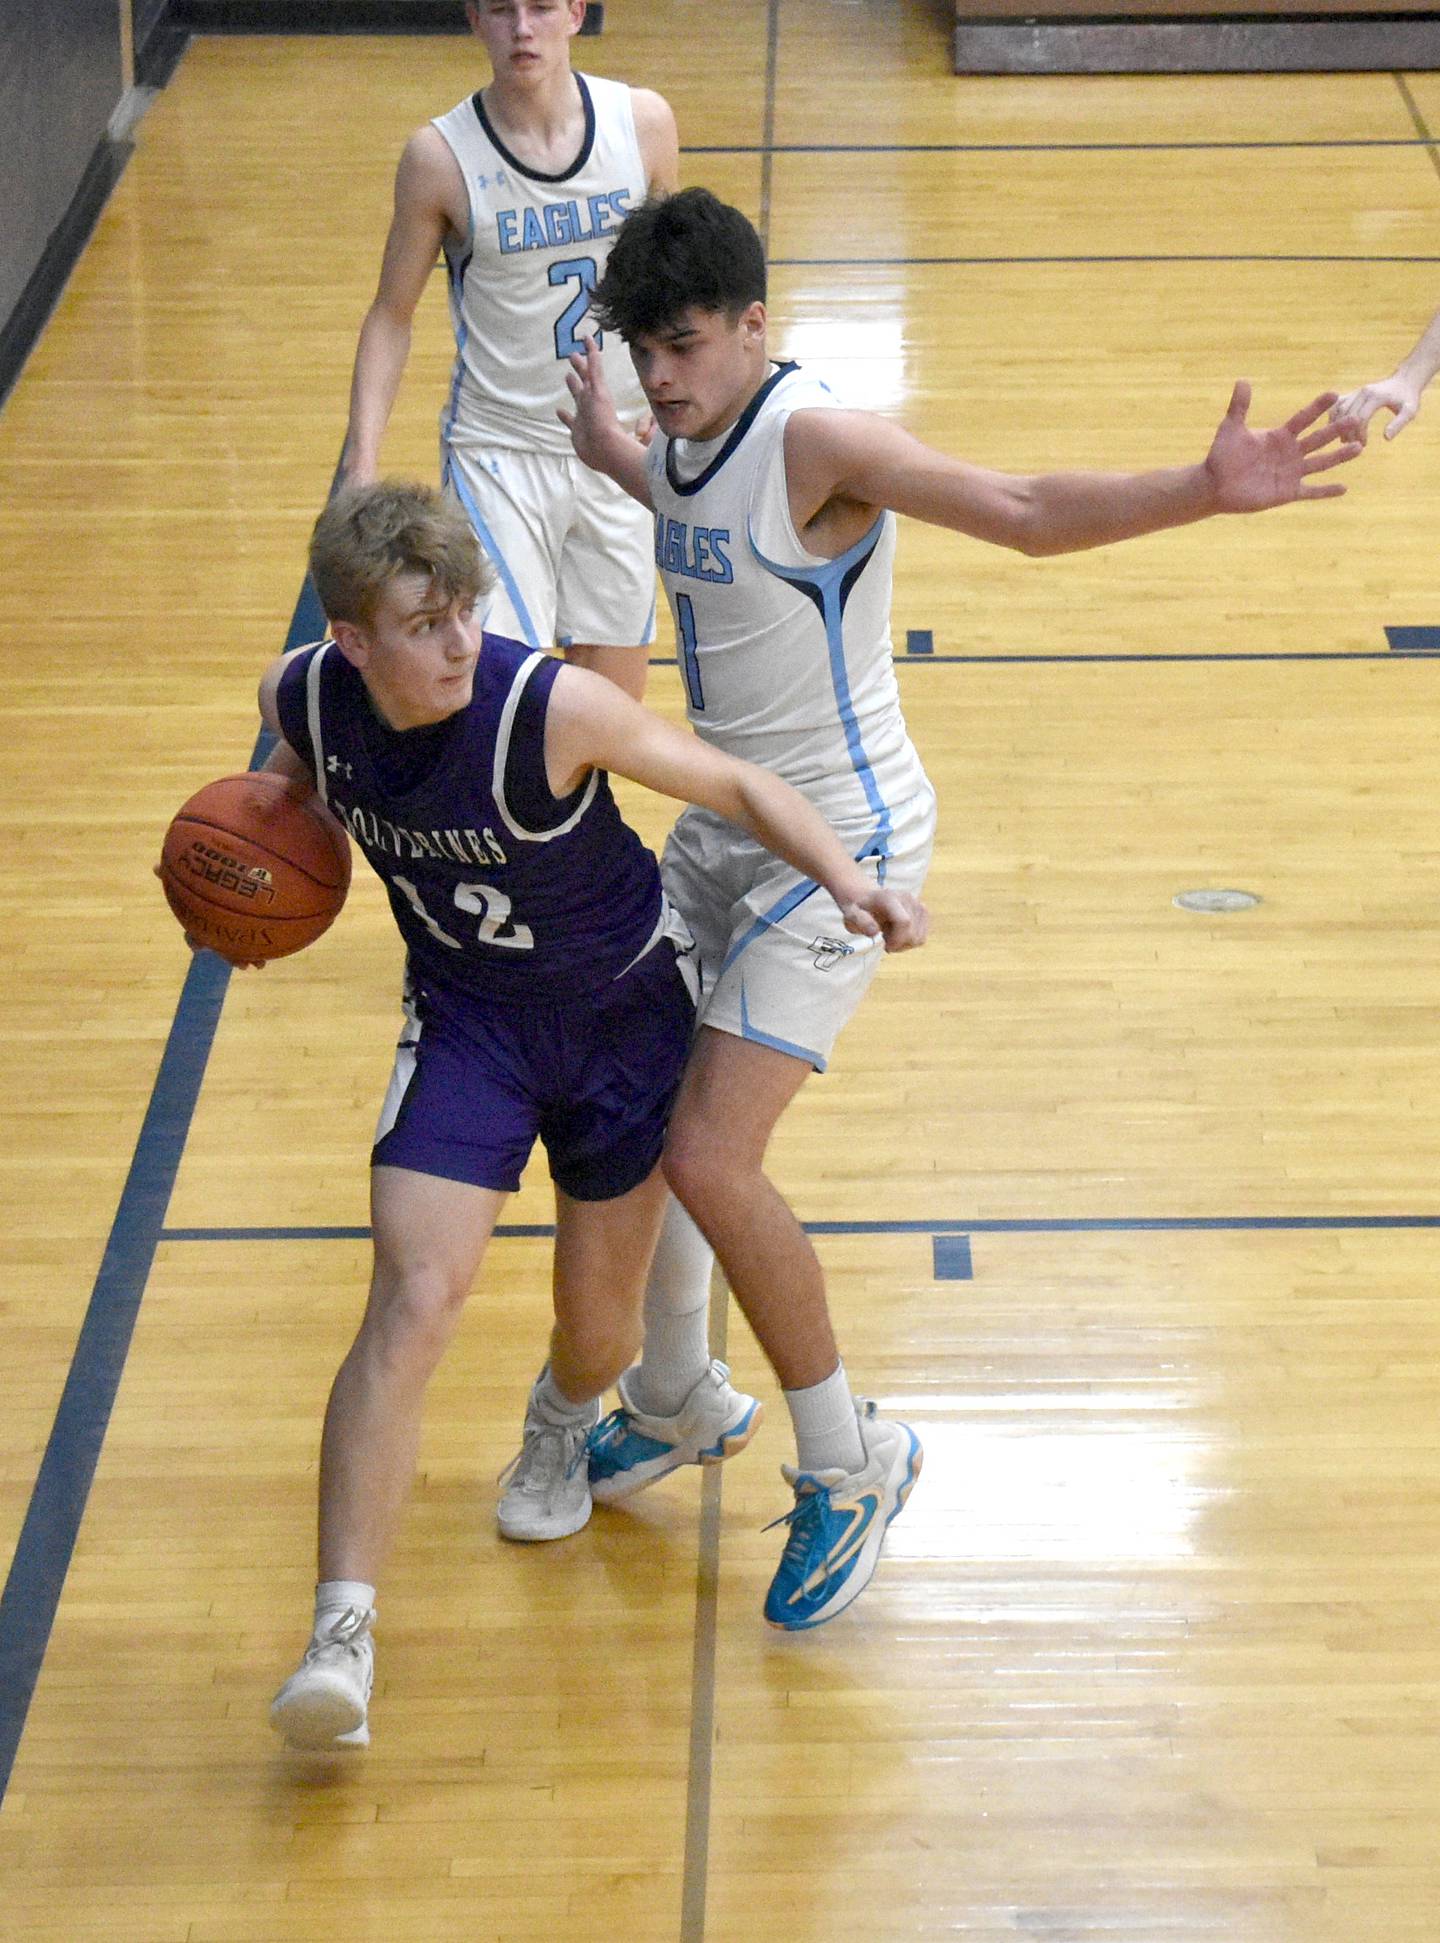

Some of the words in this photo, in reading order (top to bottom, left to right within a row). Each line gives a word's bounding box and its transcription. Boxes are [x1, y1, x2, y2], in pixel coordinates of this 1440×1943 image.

[496, 188, 632, 254] EAGLES
[547, 256, 603, 360] 2
[655, 512, 734, 584] AGLES
[675, 592, 705, 711] 1
[177, 852, 277, 904] LEGACY
[392, 875, 534, 949] 12
